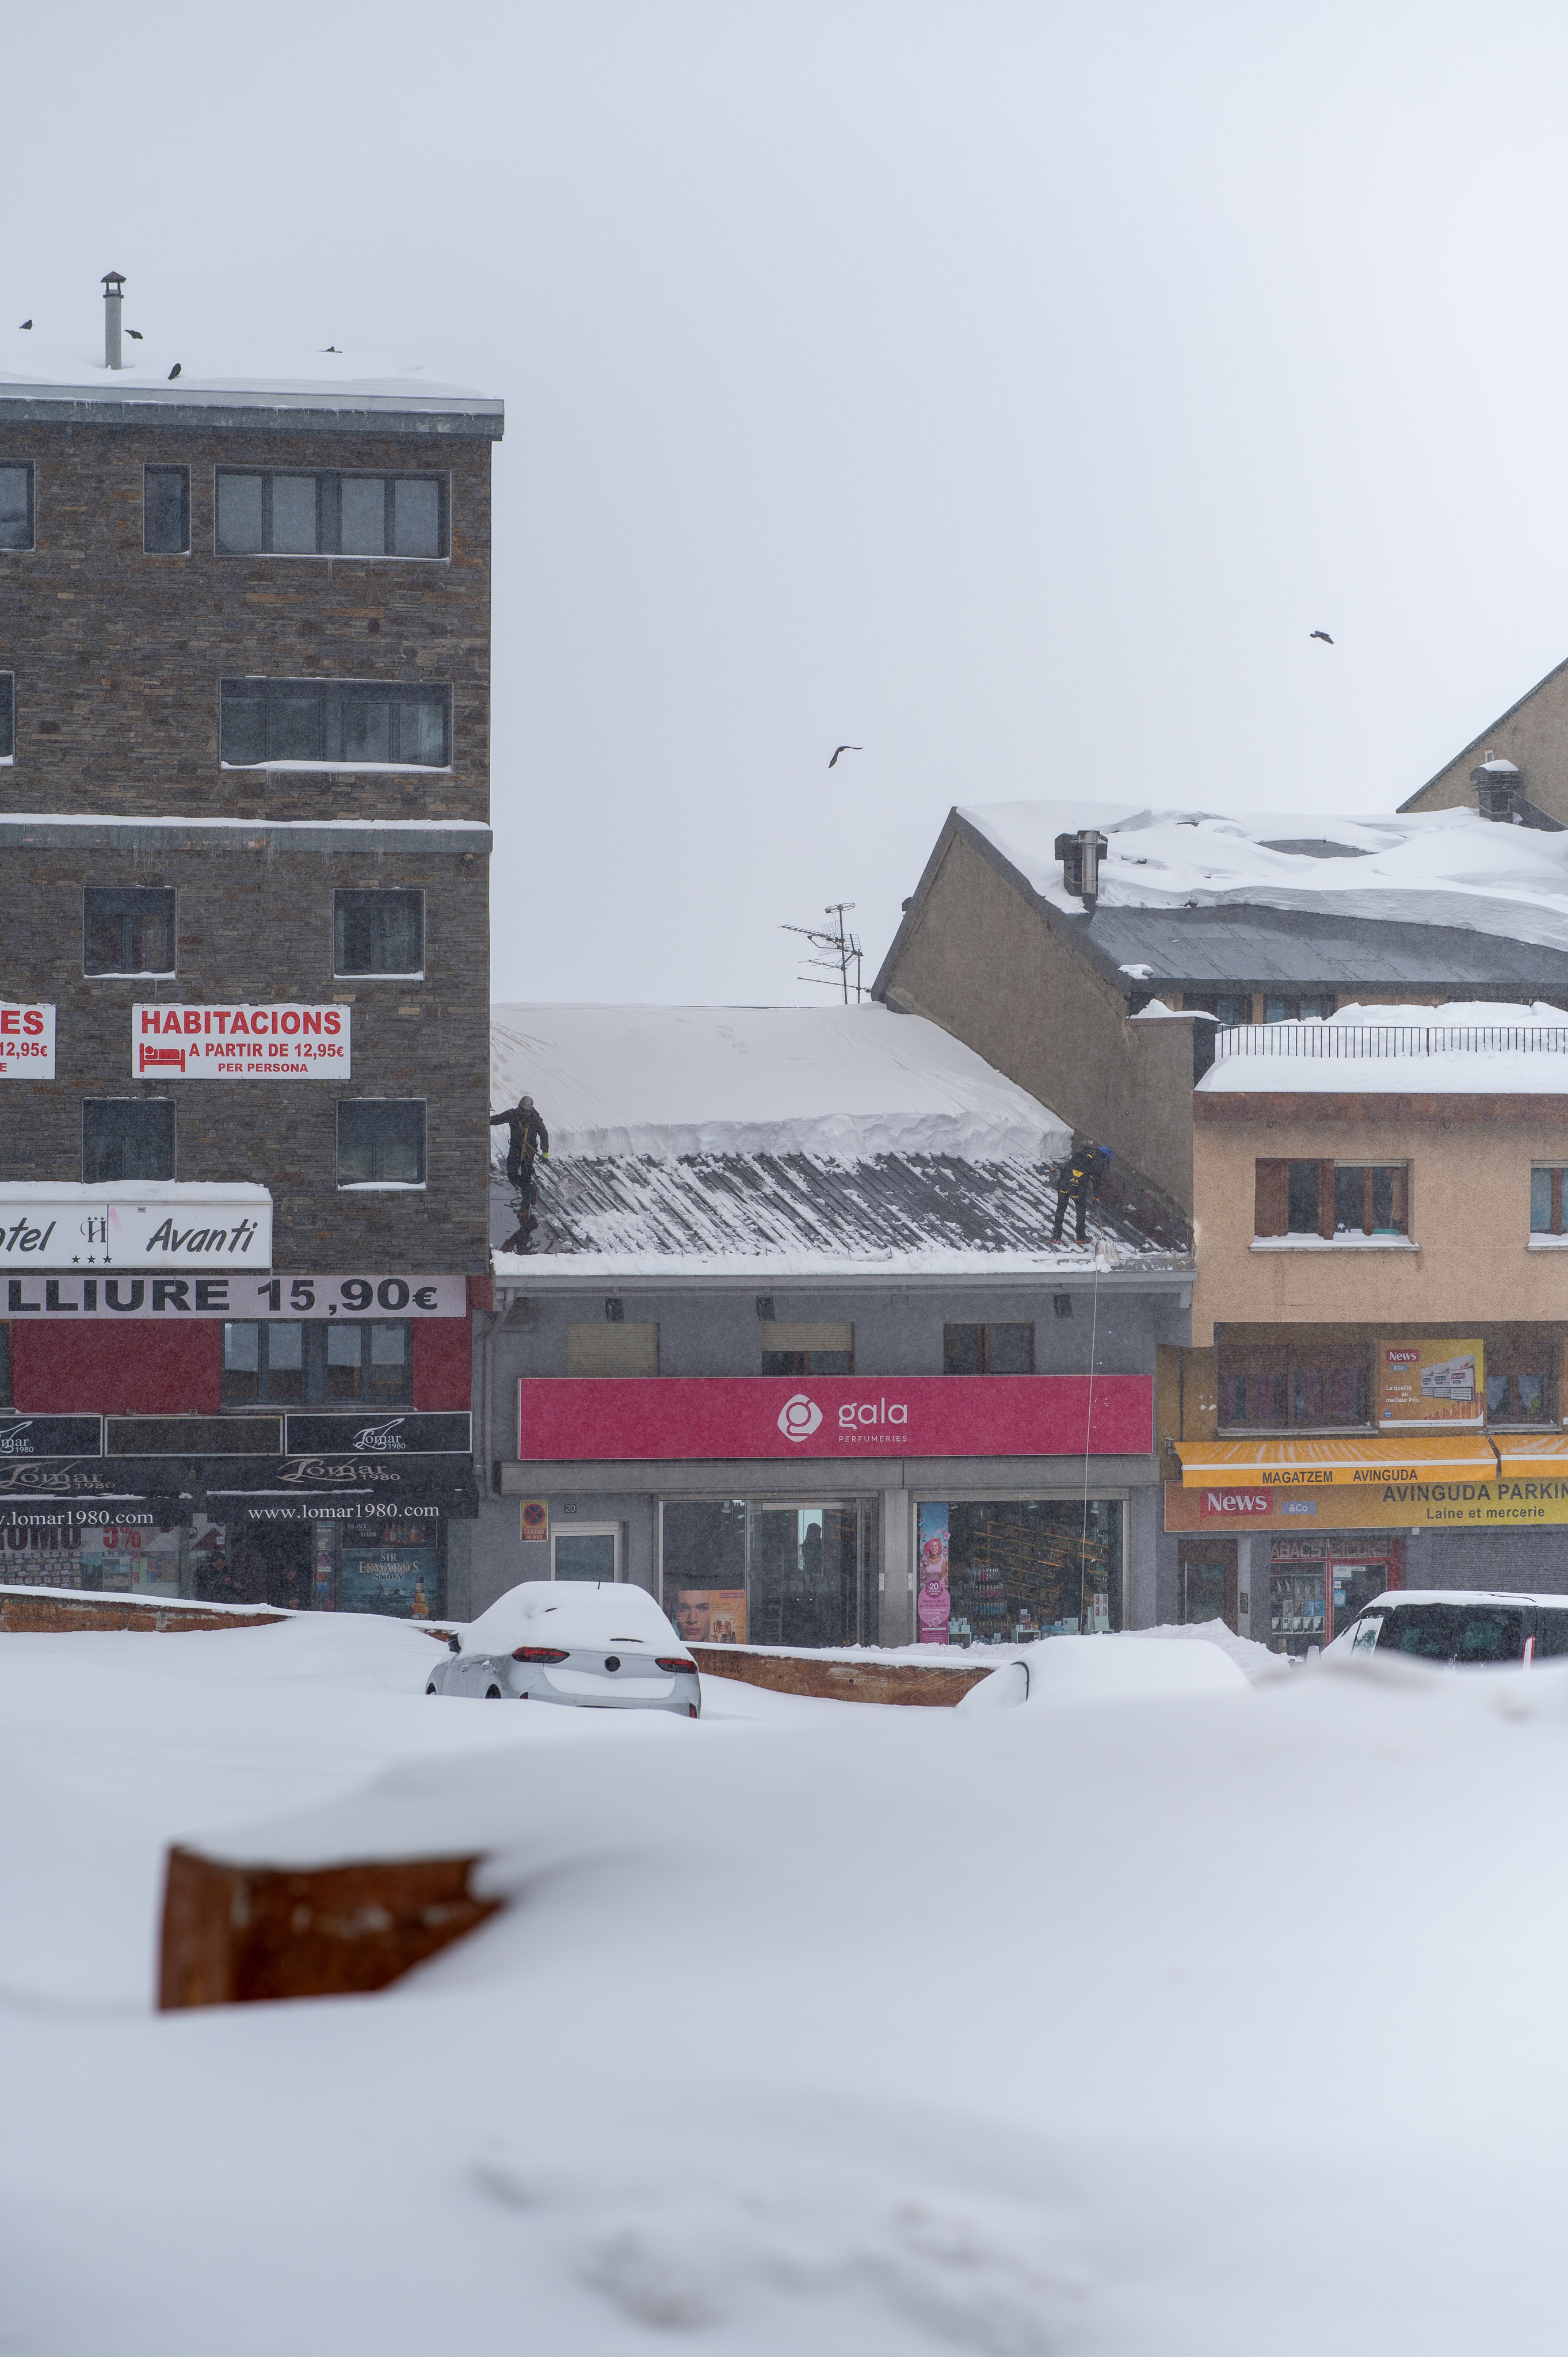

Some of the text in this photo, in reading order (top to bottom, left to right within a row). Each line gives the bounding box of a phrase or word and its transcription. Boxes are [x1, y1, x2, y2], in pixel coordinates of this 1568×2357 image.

[142, 1010, 341, 1035] HABITACIONS
[189, 1043, 344, 1060] A PARTIR DE 12,95€
[218, 1063, 308, 1072] PER PERSONA
[0, 1218, 56, 1252] tel
[146, 1218, 258, 1253] Avanti
[8, 1279, 230, 1311] LLIURE
[1389, 1352, 1417, 1360] News
[838, 1397, 907, 1429] gala
[353, 1418, 405, 1450] Lomar
[276, 1458, 388, 1482] Lomar
[1262, 1469, 1418, 1484] MAGATZEM AVINGUDA
[1382, 1483, 1491, 1502] AVINGUDA
[565, 1504, 576, 1512] 20
[1207, 1492, 1268, 1512] News
[1289, 1503, 1308, 1512] &Co
[247, 1503, 440, 1519] www.lomar1980.com
[1427, 1506, 1546, 1519] Laine et mercerie
[380, 1553, 397, 1561] SIR
[359, 1561, 419, 1574] EDWARD'S
